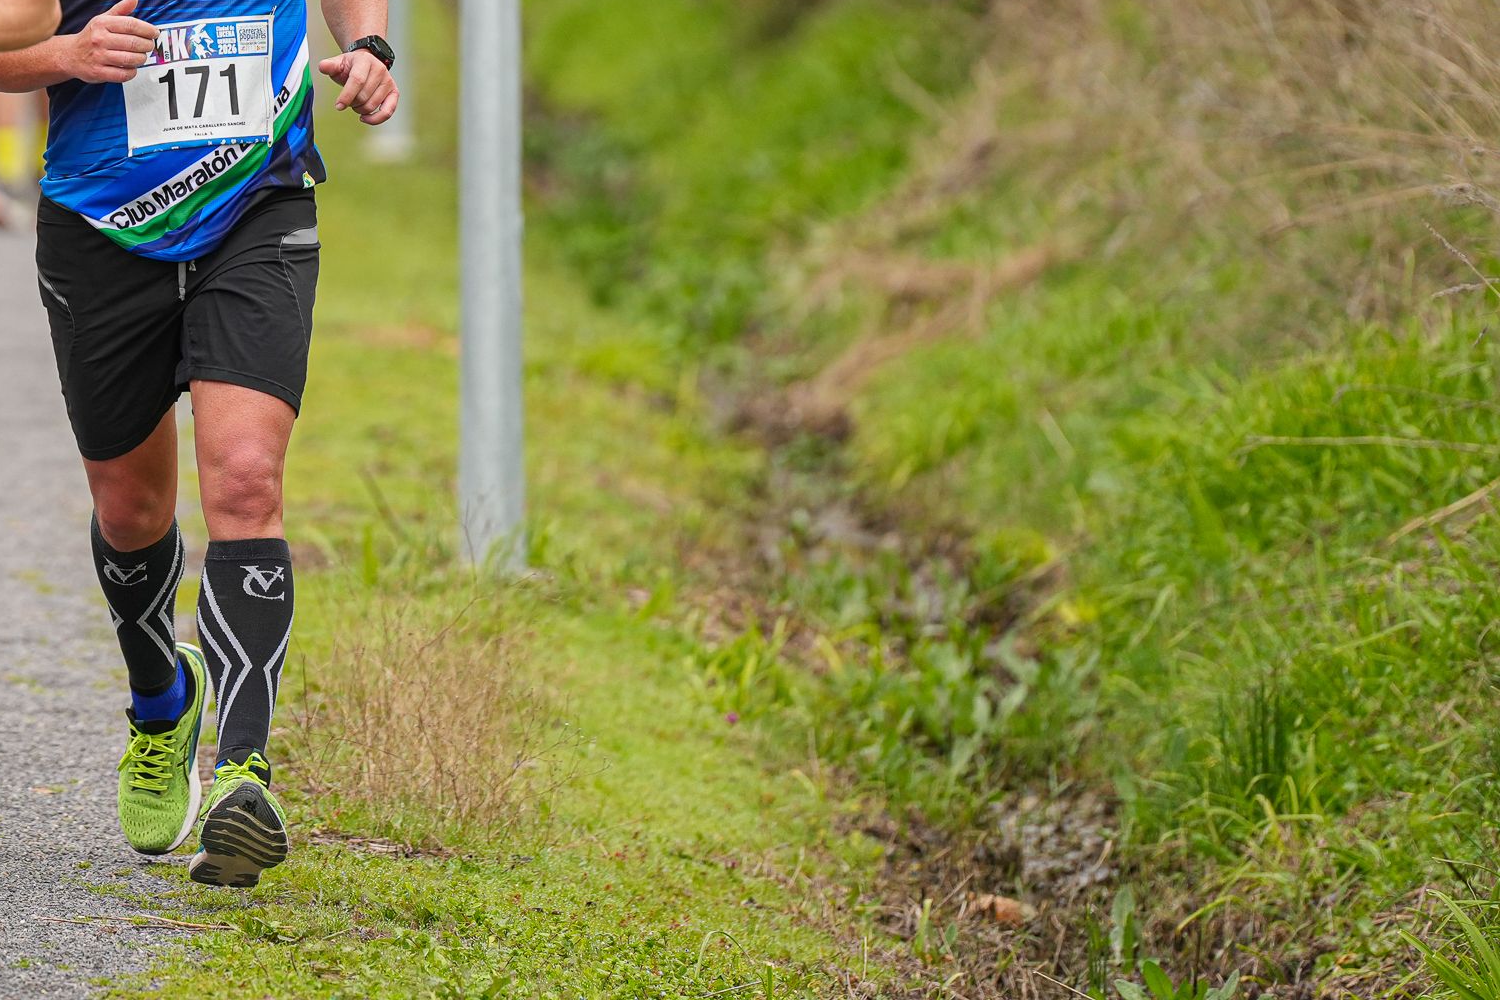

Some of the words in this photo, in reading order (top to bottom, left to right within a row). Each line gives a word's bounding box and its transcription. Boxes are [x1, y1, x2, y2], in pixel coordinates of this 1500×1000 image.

[218, 43, 238, 55] 2026
[158, 63, 240, 120] 171
[109, 200, 157, 230] Club
[151, 144, 239, 210] Maratón
